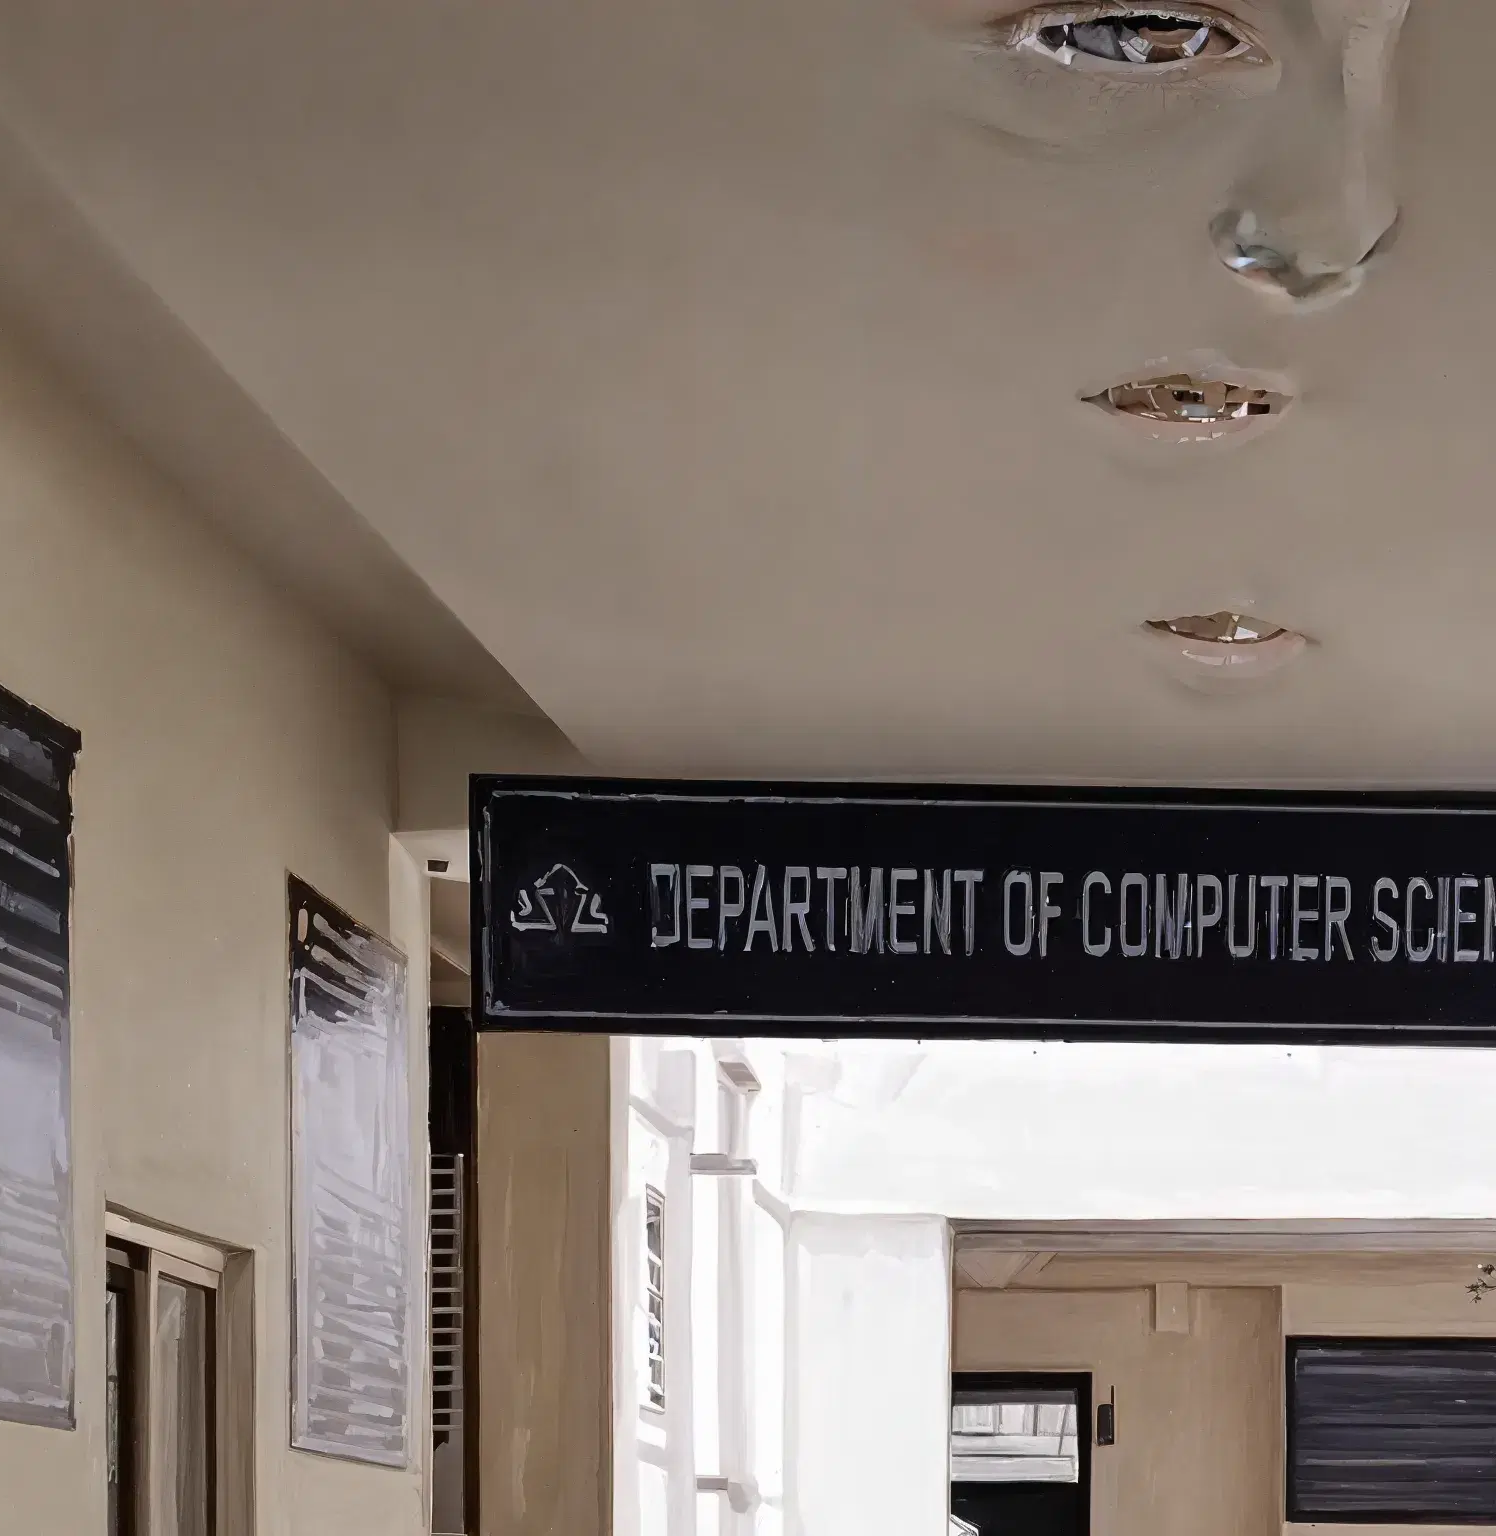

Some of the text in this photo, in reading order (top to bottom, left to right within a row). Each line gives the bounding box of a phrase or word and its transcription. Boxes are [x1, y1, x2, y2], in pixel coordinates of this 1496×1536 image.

[650, 863, 985, 956] DEPARTMENT
[1003, 869, 1064, 958] OF
[1081, 871, 1355, 962] COMPUTER
